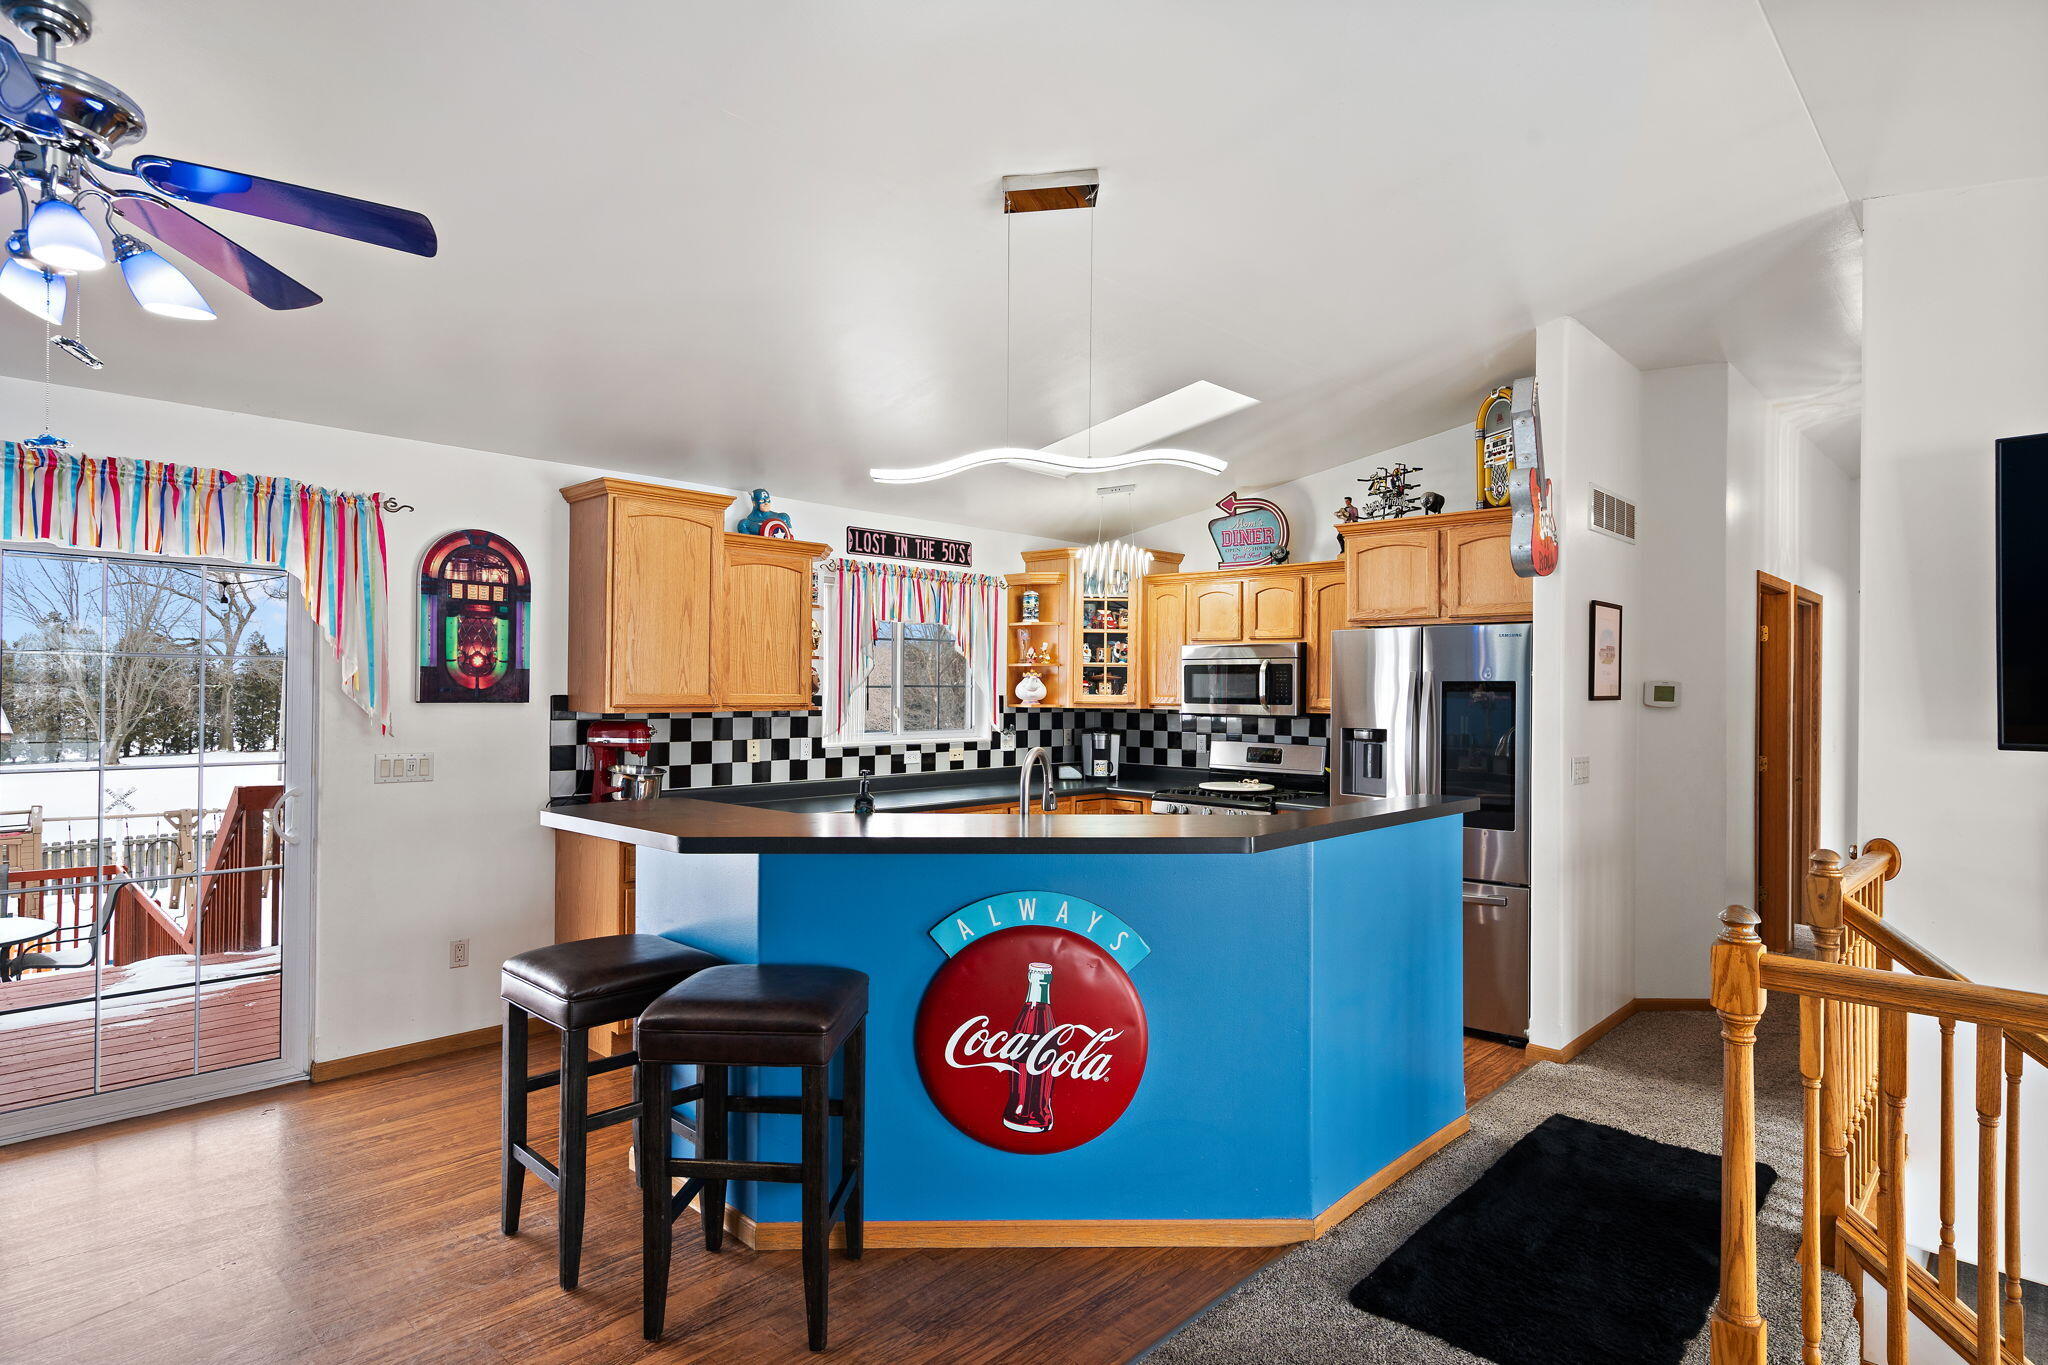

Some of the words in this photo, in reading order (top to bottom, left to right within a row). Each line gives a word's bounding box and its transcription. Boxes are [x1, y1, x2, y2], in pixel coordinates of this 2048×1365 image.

[1221, 527, 1276, 547] DINER
[1232, 518, 1264, 529] Mom's
[854, 530, 888, 554] LOST
[894, 536, 908, 557] IN
[915, 539, 935, 560] THE
[942, 542, 966, 564] 50'S
[957, 898, 1128, 951] ALWAYS
[944, 1015, 1125, 1082] Coca-Cola
